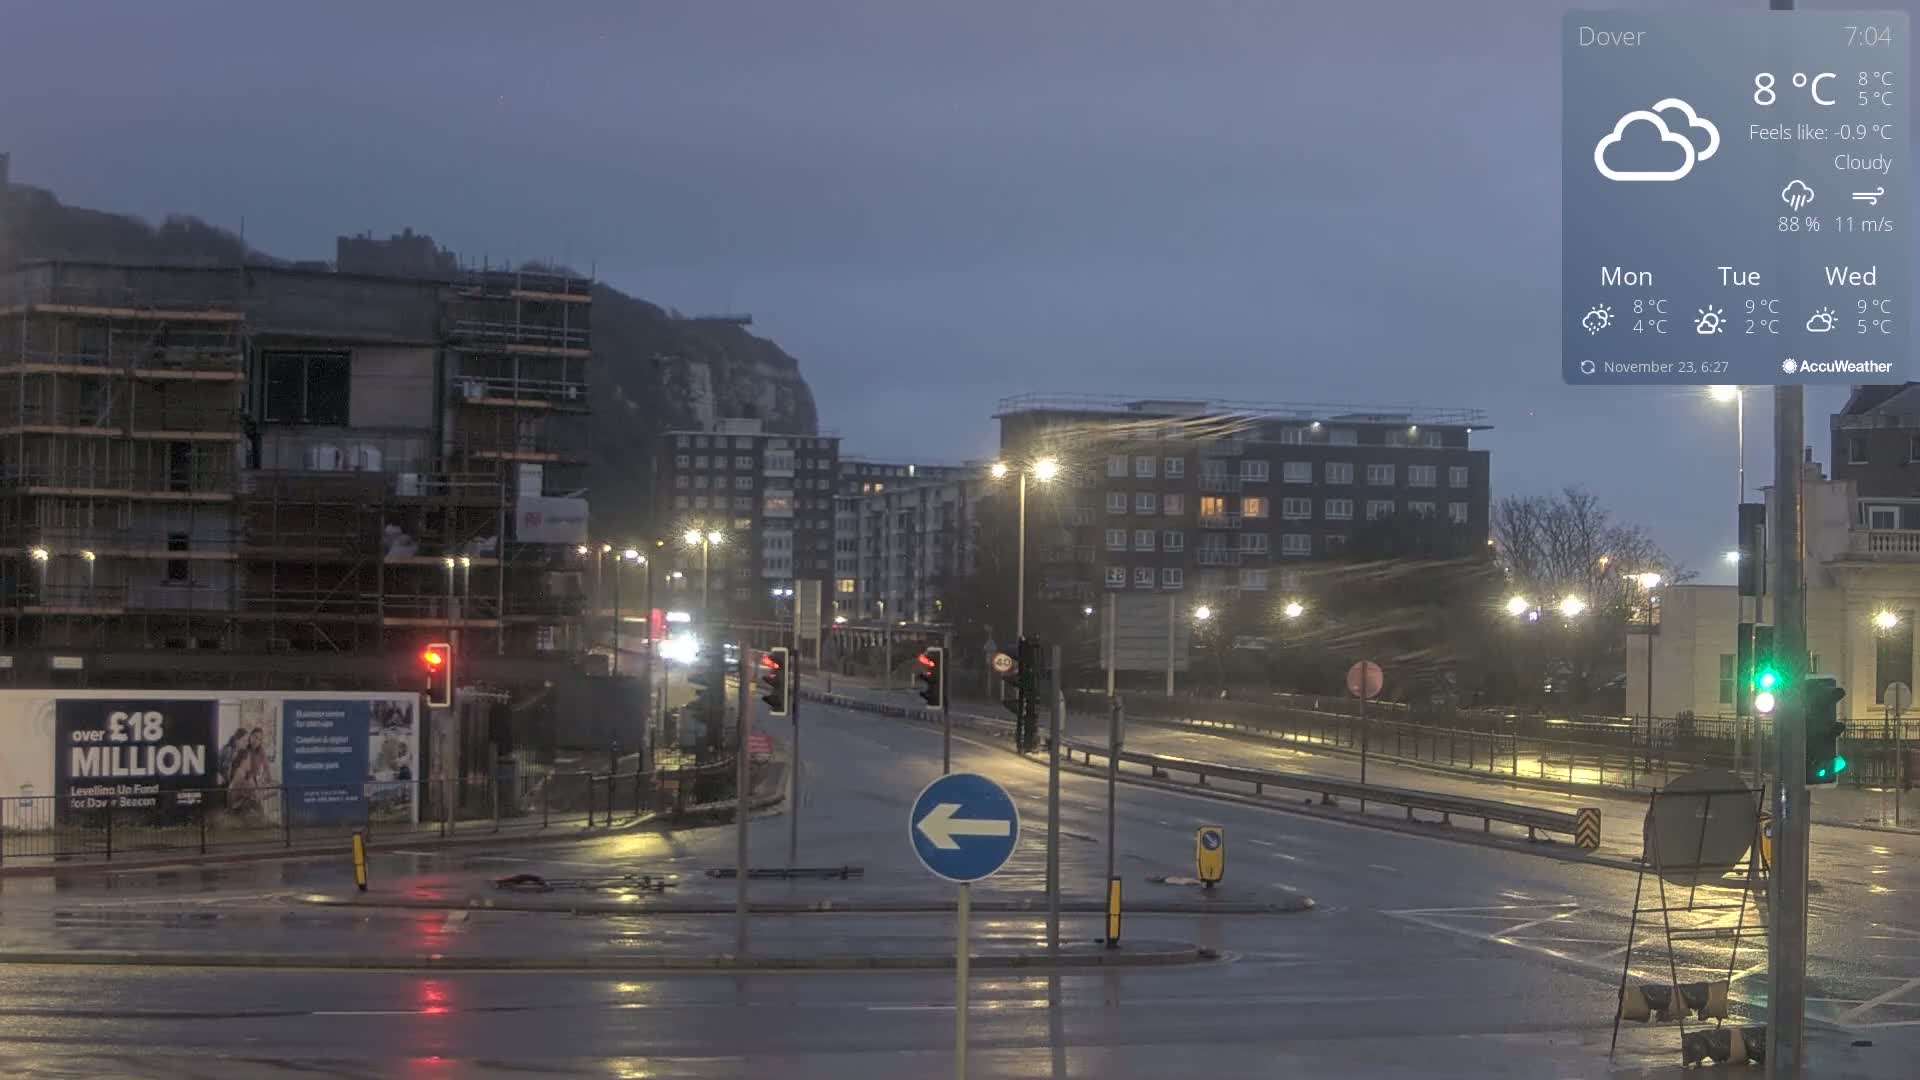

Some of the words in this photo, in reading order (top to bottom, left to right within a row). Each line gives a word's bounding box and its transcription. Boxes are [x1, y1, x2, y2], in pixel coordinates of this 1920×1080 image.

[996, 658, 1010, 667] 40
[72, 729, 105, 742] over
[110, 711, 164, 742] £18
[71, 745, 206, 777] MILLION
[134, 783, 160, 794] Fund
[88, 797, 117, 808] Dovr
